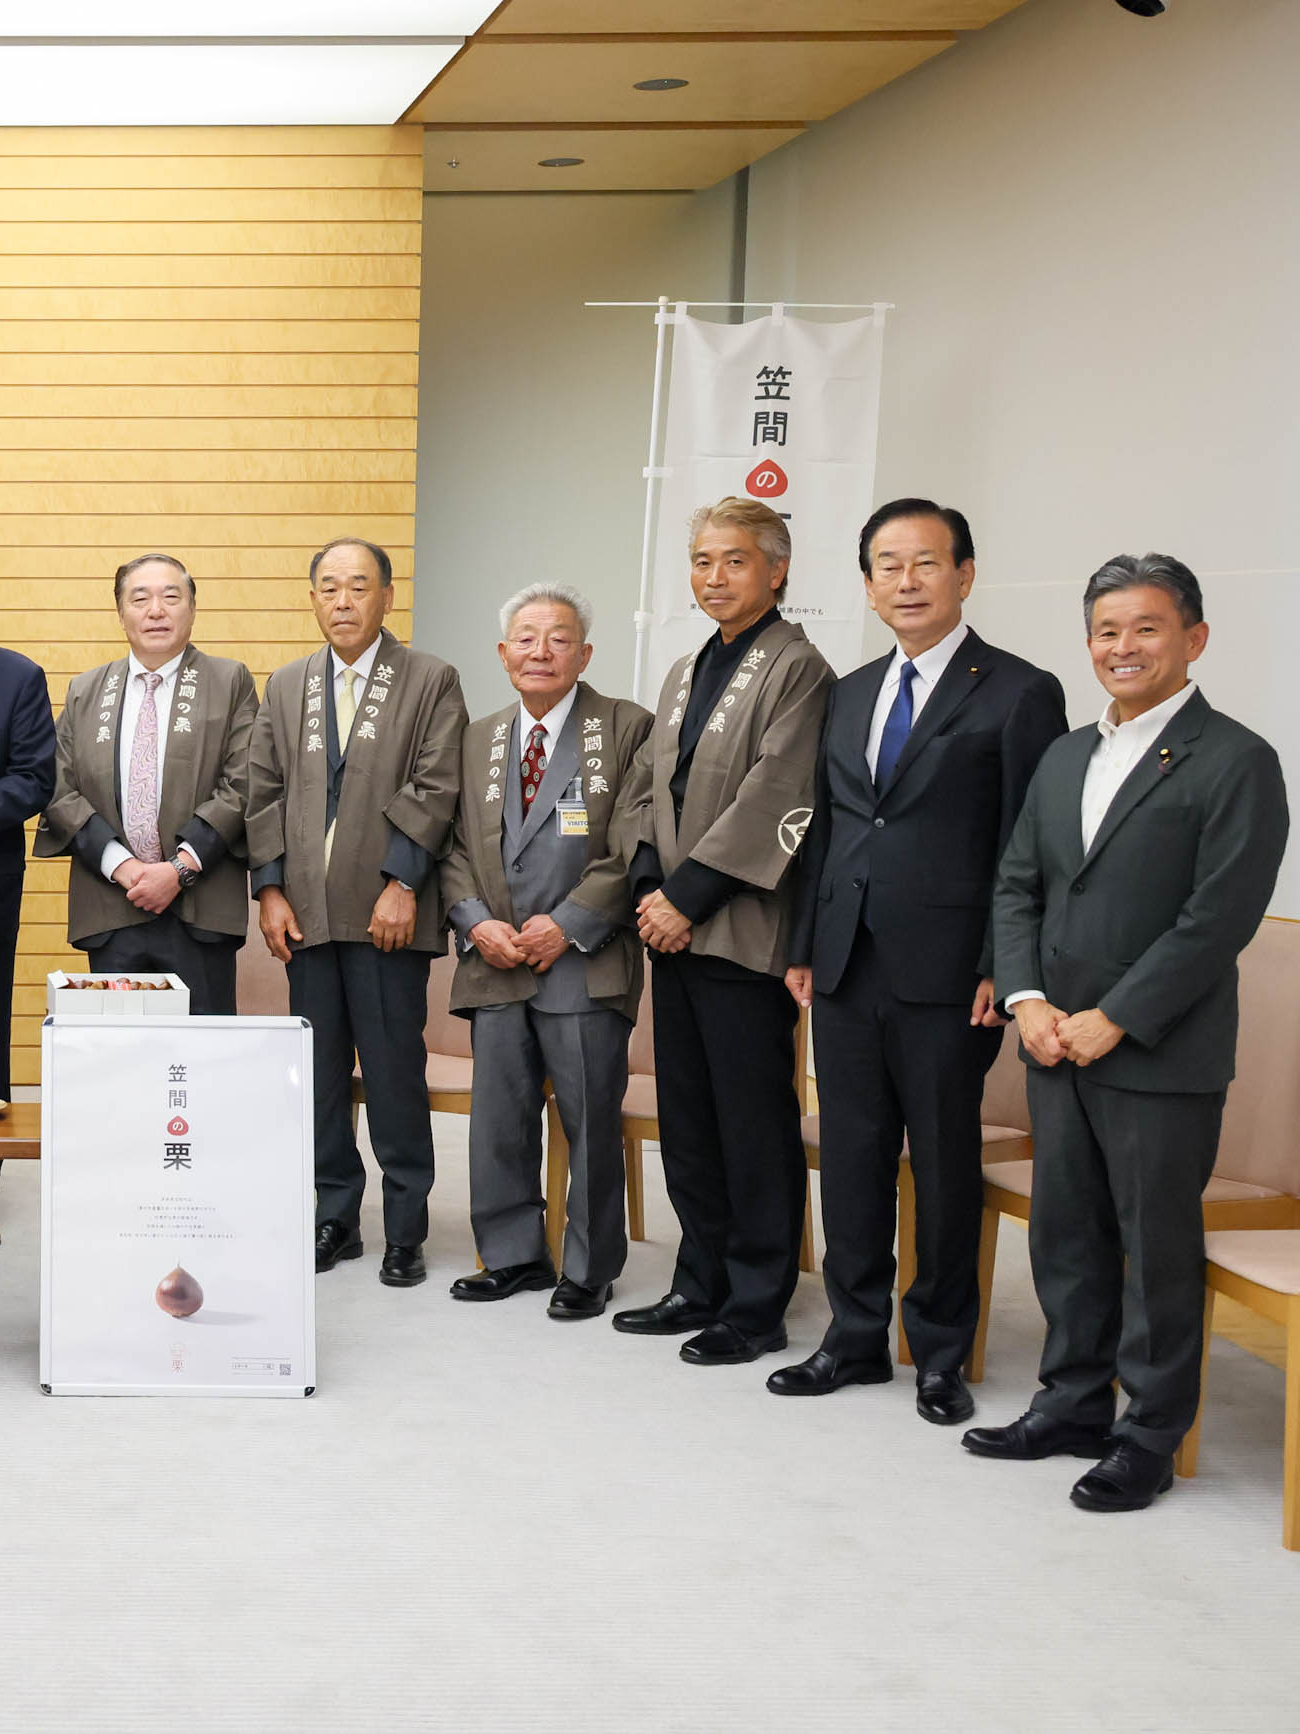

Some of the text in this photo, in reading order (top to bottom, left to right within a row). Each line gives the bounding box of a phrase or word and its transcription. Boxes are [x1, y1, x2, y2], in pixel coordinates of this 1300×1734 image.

[753, 366, 792, 519] 笠間の
[96, 674, 120, 743] 笠間の栗
[173, 666, 198, 733] 笠間の栗
[307, 675, 324, 752] 笠間の栗
[356, 664, 395, 740] 笠間の栗
[708, 648, 766, 733] 笠間の栗
[485, 723, 508, 802] 笠間の栗
[583, 718, 609, 794] 笠間の栗
[163, 1064, 192, 1170] 笠間の栗
